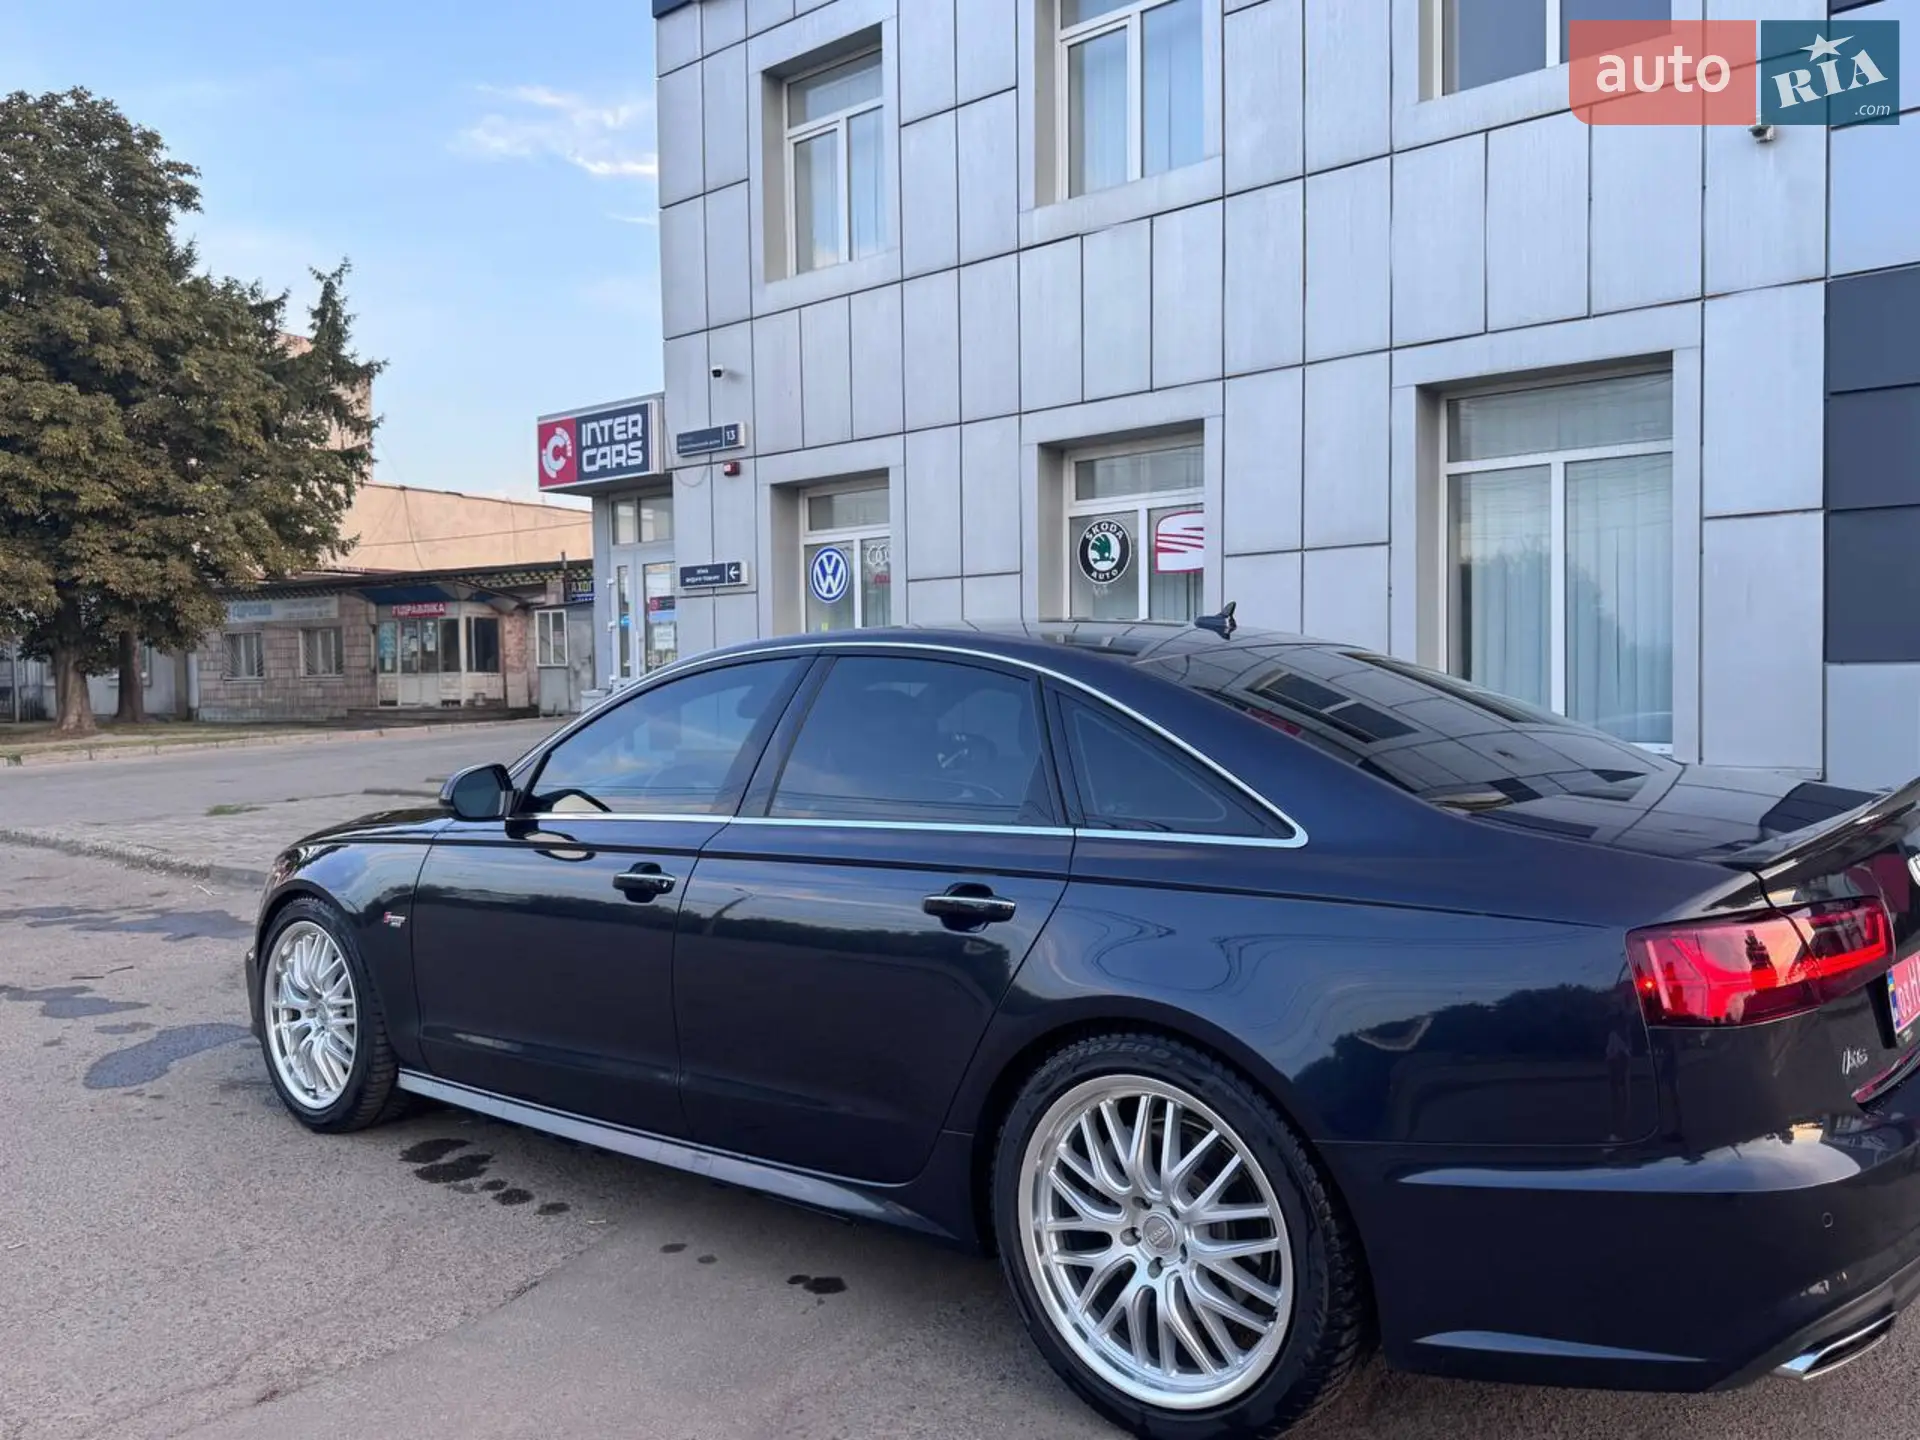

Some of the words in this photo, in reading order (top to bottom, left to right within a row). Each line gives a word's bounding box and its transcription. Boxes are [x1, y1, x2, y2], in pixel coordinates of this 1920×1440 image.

[582, 413, 642, 447] INTER
[726, 430, 736, 440] 13
[583, 441, 643, 472] CARS
[1091, 569, 1118, 579] AUTO
